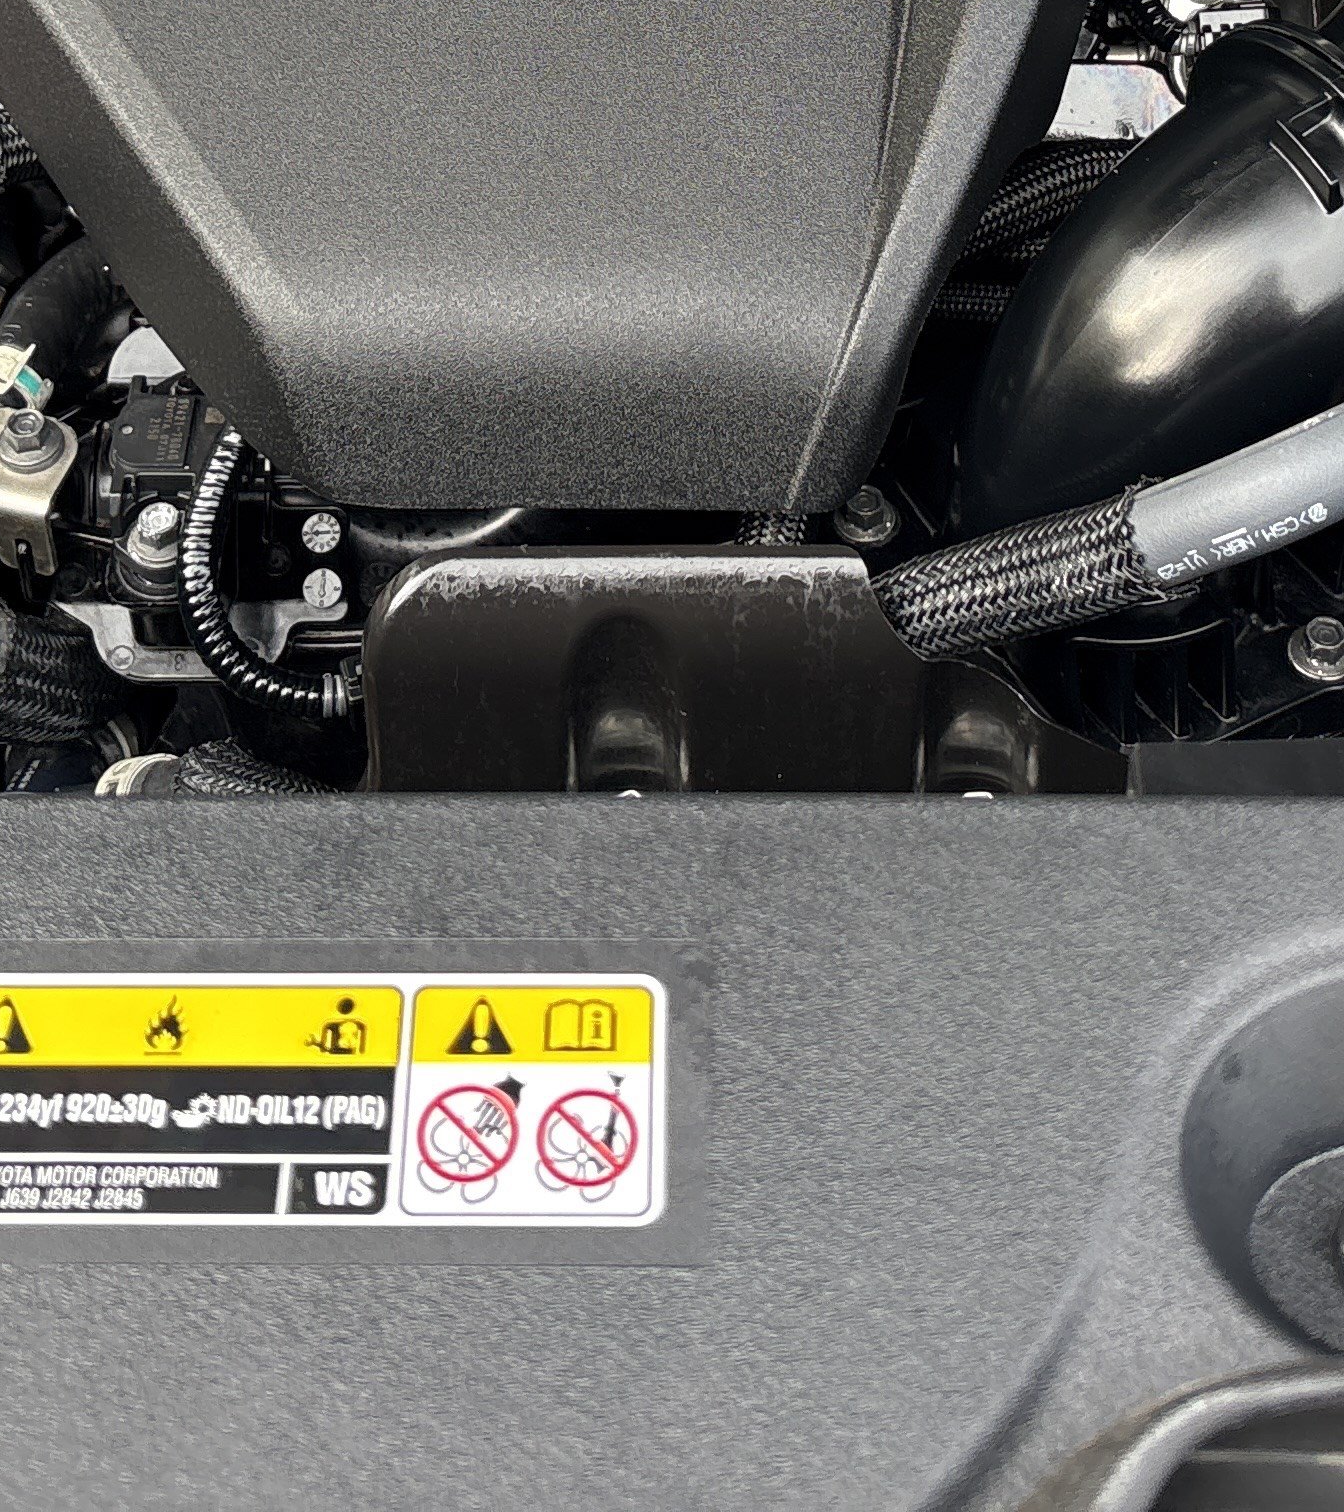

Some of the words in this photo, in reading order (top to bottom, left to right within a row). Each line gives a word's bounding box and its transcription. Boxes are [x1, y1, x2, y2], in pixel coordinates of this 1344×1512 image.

[65, 1093, 167, 1129] 920±30g
[217, 1094, 320, 1125] ND-OIL12
[323, 1094, 387, 1130] (PAG)
[36, 1165, 97, 1187] MOTOR
[100, 1165, 220, 1189] CORPORATION
[314, 1170, 376, 1207] WS
[0, 1187, 41, 1209] J639
[43, 1187, 93, 1209] J2842
[95, 1187, 145, 1210] J2845
